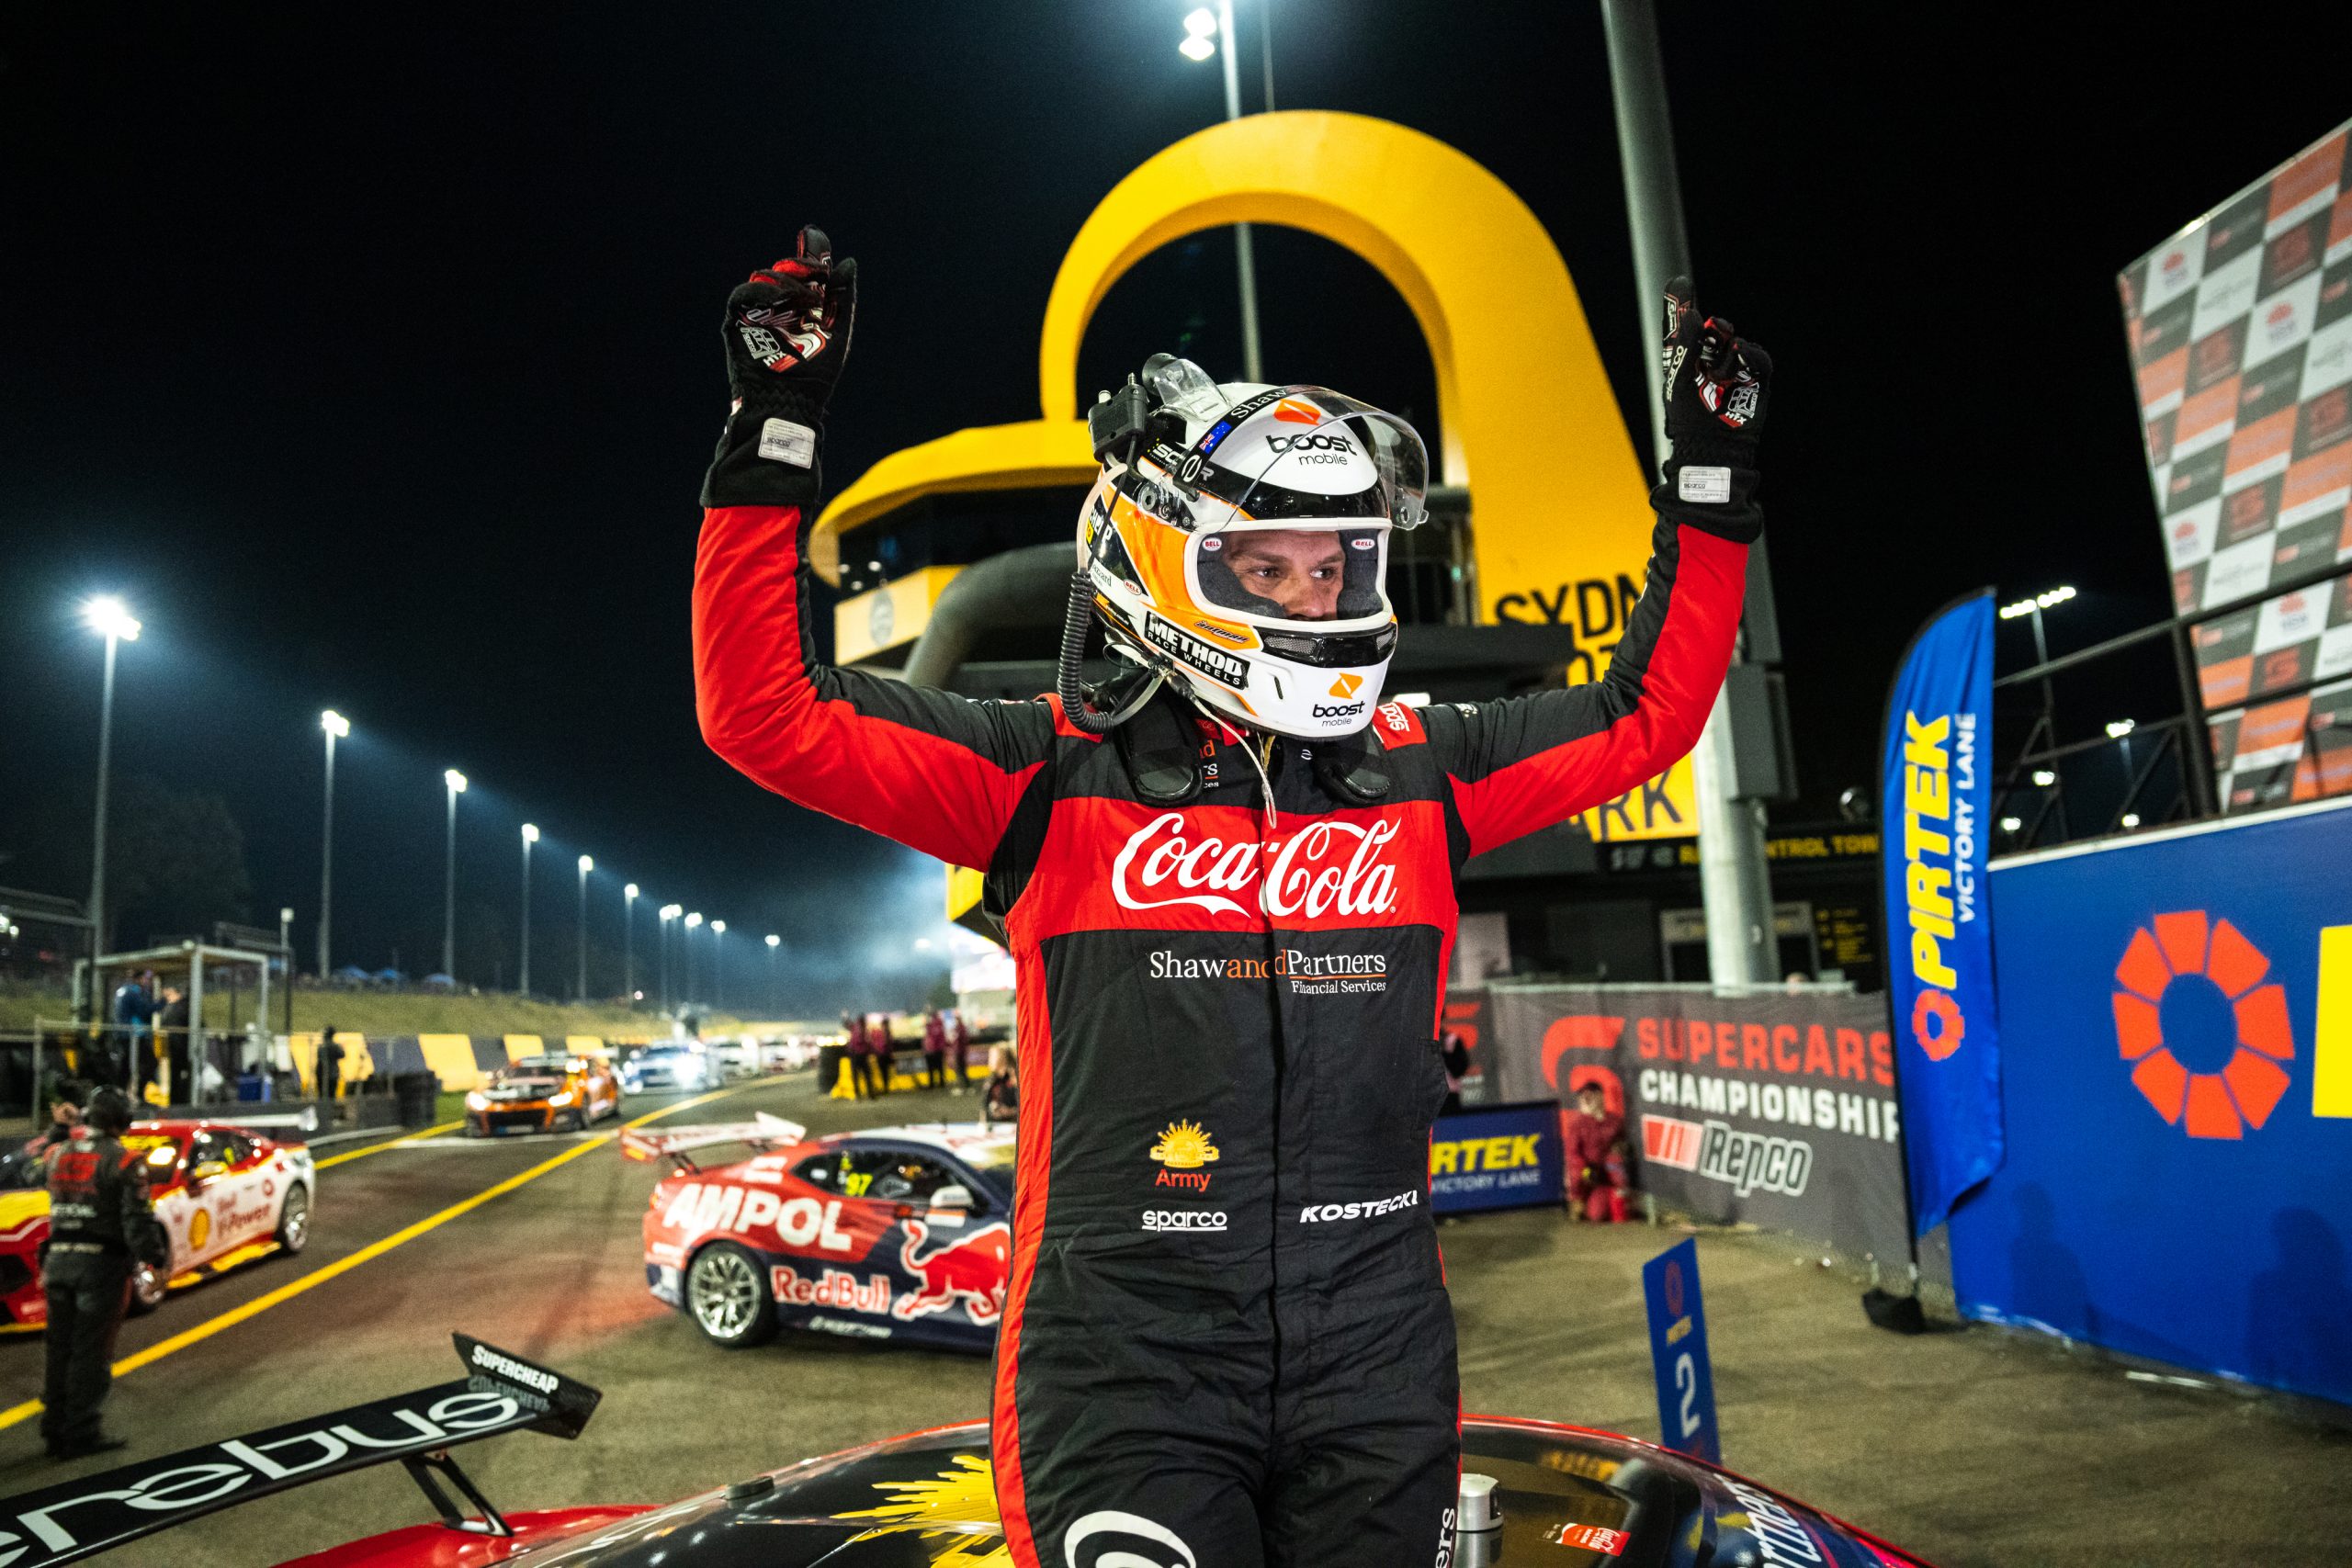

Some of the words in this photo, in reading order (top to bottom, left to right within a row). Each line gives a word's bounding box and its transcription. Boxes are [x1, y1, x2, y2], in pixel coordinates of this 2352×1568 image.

[1230, 389, 1287, 419] Shaw
[1266, 434, 1357, 456] boost
[1298, 453, 1348, 466] mobile
[1148, 632, 1177, 654] RACE
[1184, 652, 1241, 685] WHEELS
[1149, 618, 1243, 677] METHOD
[1312, 700, 1365, 718] boost
[1321, 717, 1352, 728] mobile
[1955, 713, 1976, 790] LANE
[1904, 709, 1957, 990] PIRTEK
[1955, 796, 1976, 922] VICTORY
[1292, 980, 1339, 995] Financial
[1340, 980, 1386, 994] Services
[1636, 1018, 1894, 1088] SUPERCARS
[1703, 1120, 1813, 1196] Repco
[1155, 1168, 1212, 1192] Army
[662, 1183, 853, 1252] AMPOL
[1141, 1210, 1227, 1232] sparco
[1299, 1190, 1419, 1224] KOSTECKI
[471, 1345, 559, 1394] SUPERCHEAP
